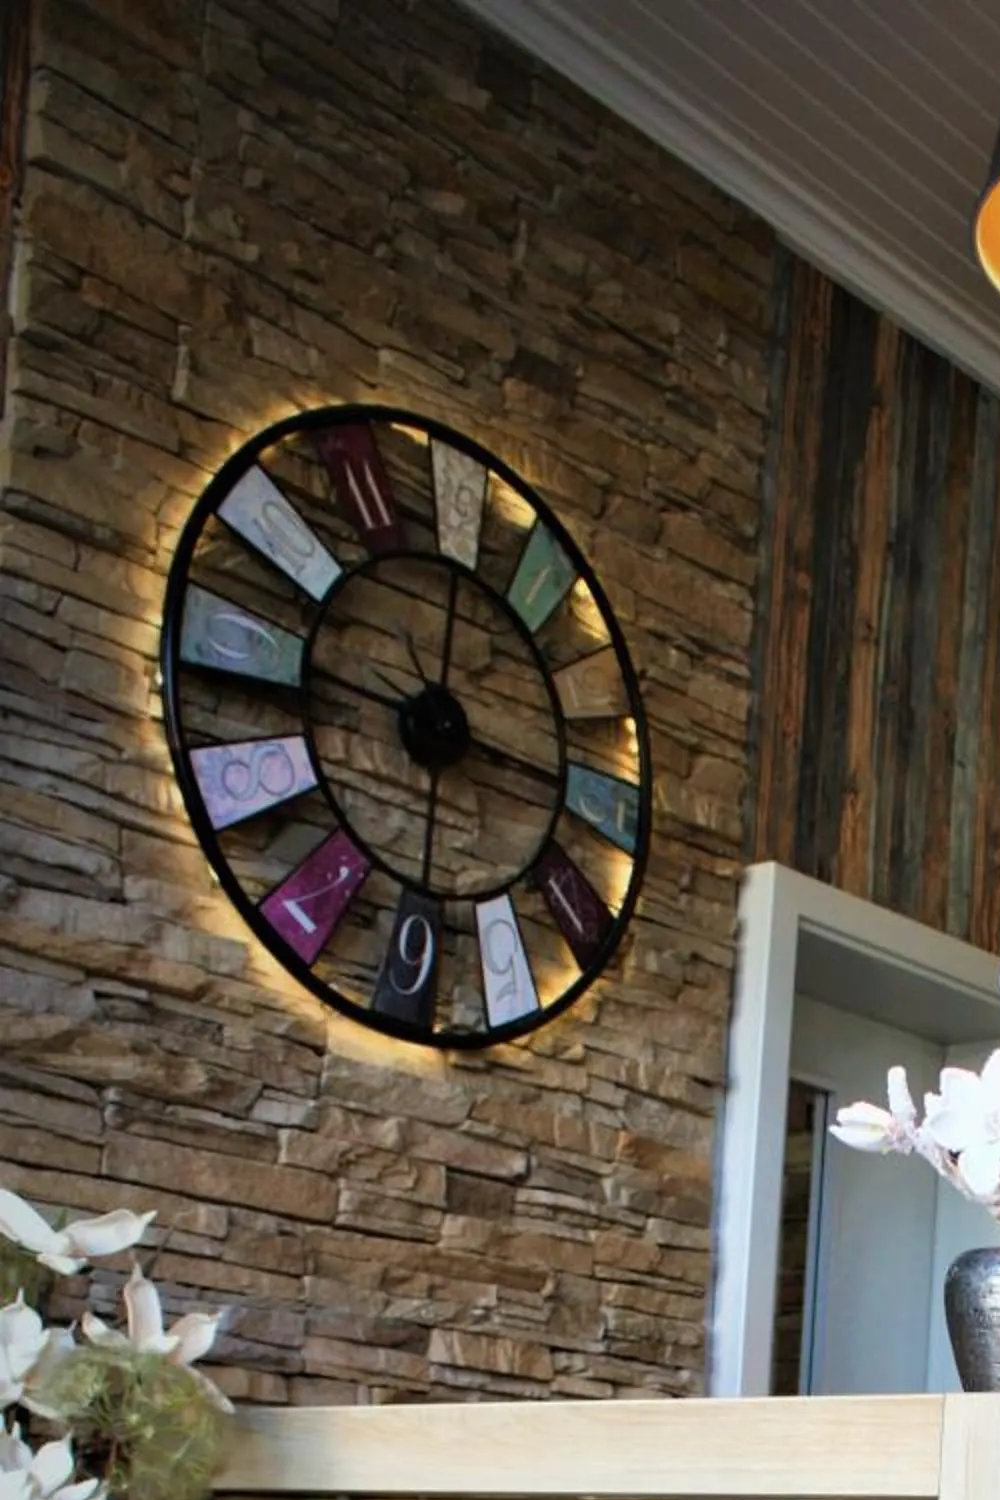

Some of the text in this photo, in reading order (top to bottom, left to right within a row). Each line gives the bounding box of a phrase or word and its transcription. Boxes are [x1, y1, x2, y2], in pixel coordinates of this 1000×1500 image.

[343, 459, 393, 529] 11
[252, 500, 320, 574] 10
[221, 741, 295, 802] 8
[282, 865, 350, 934] 7
